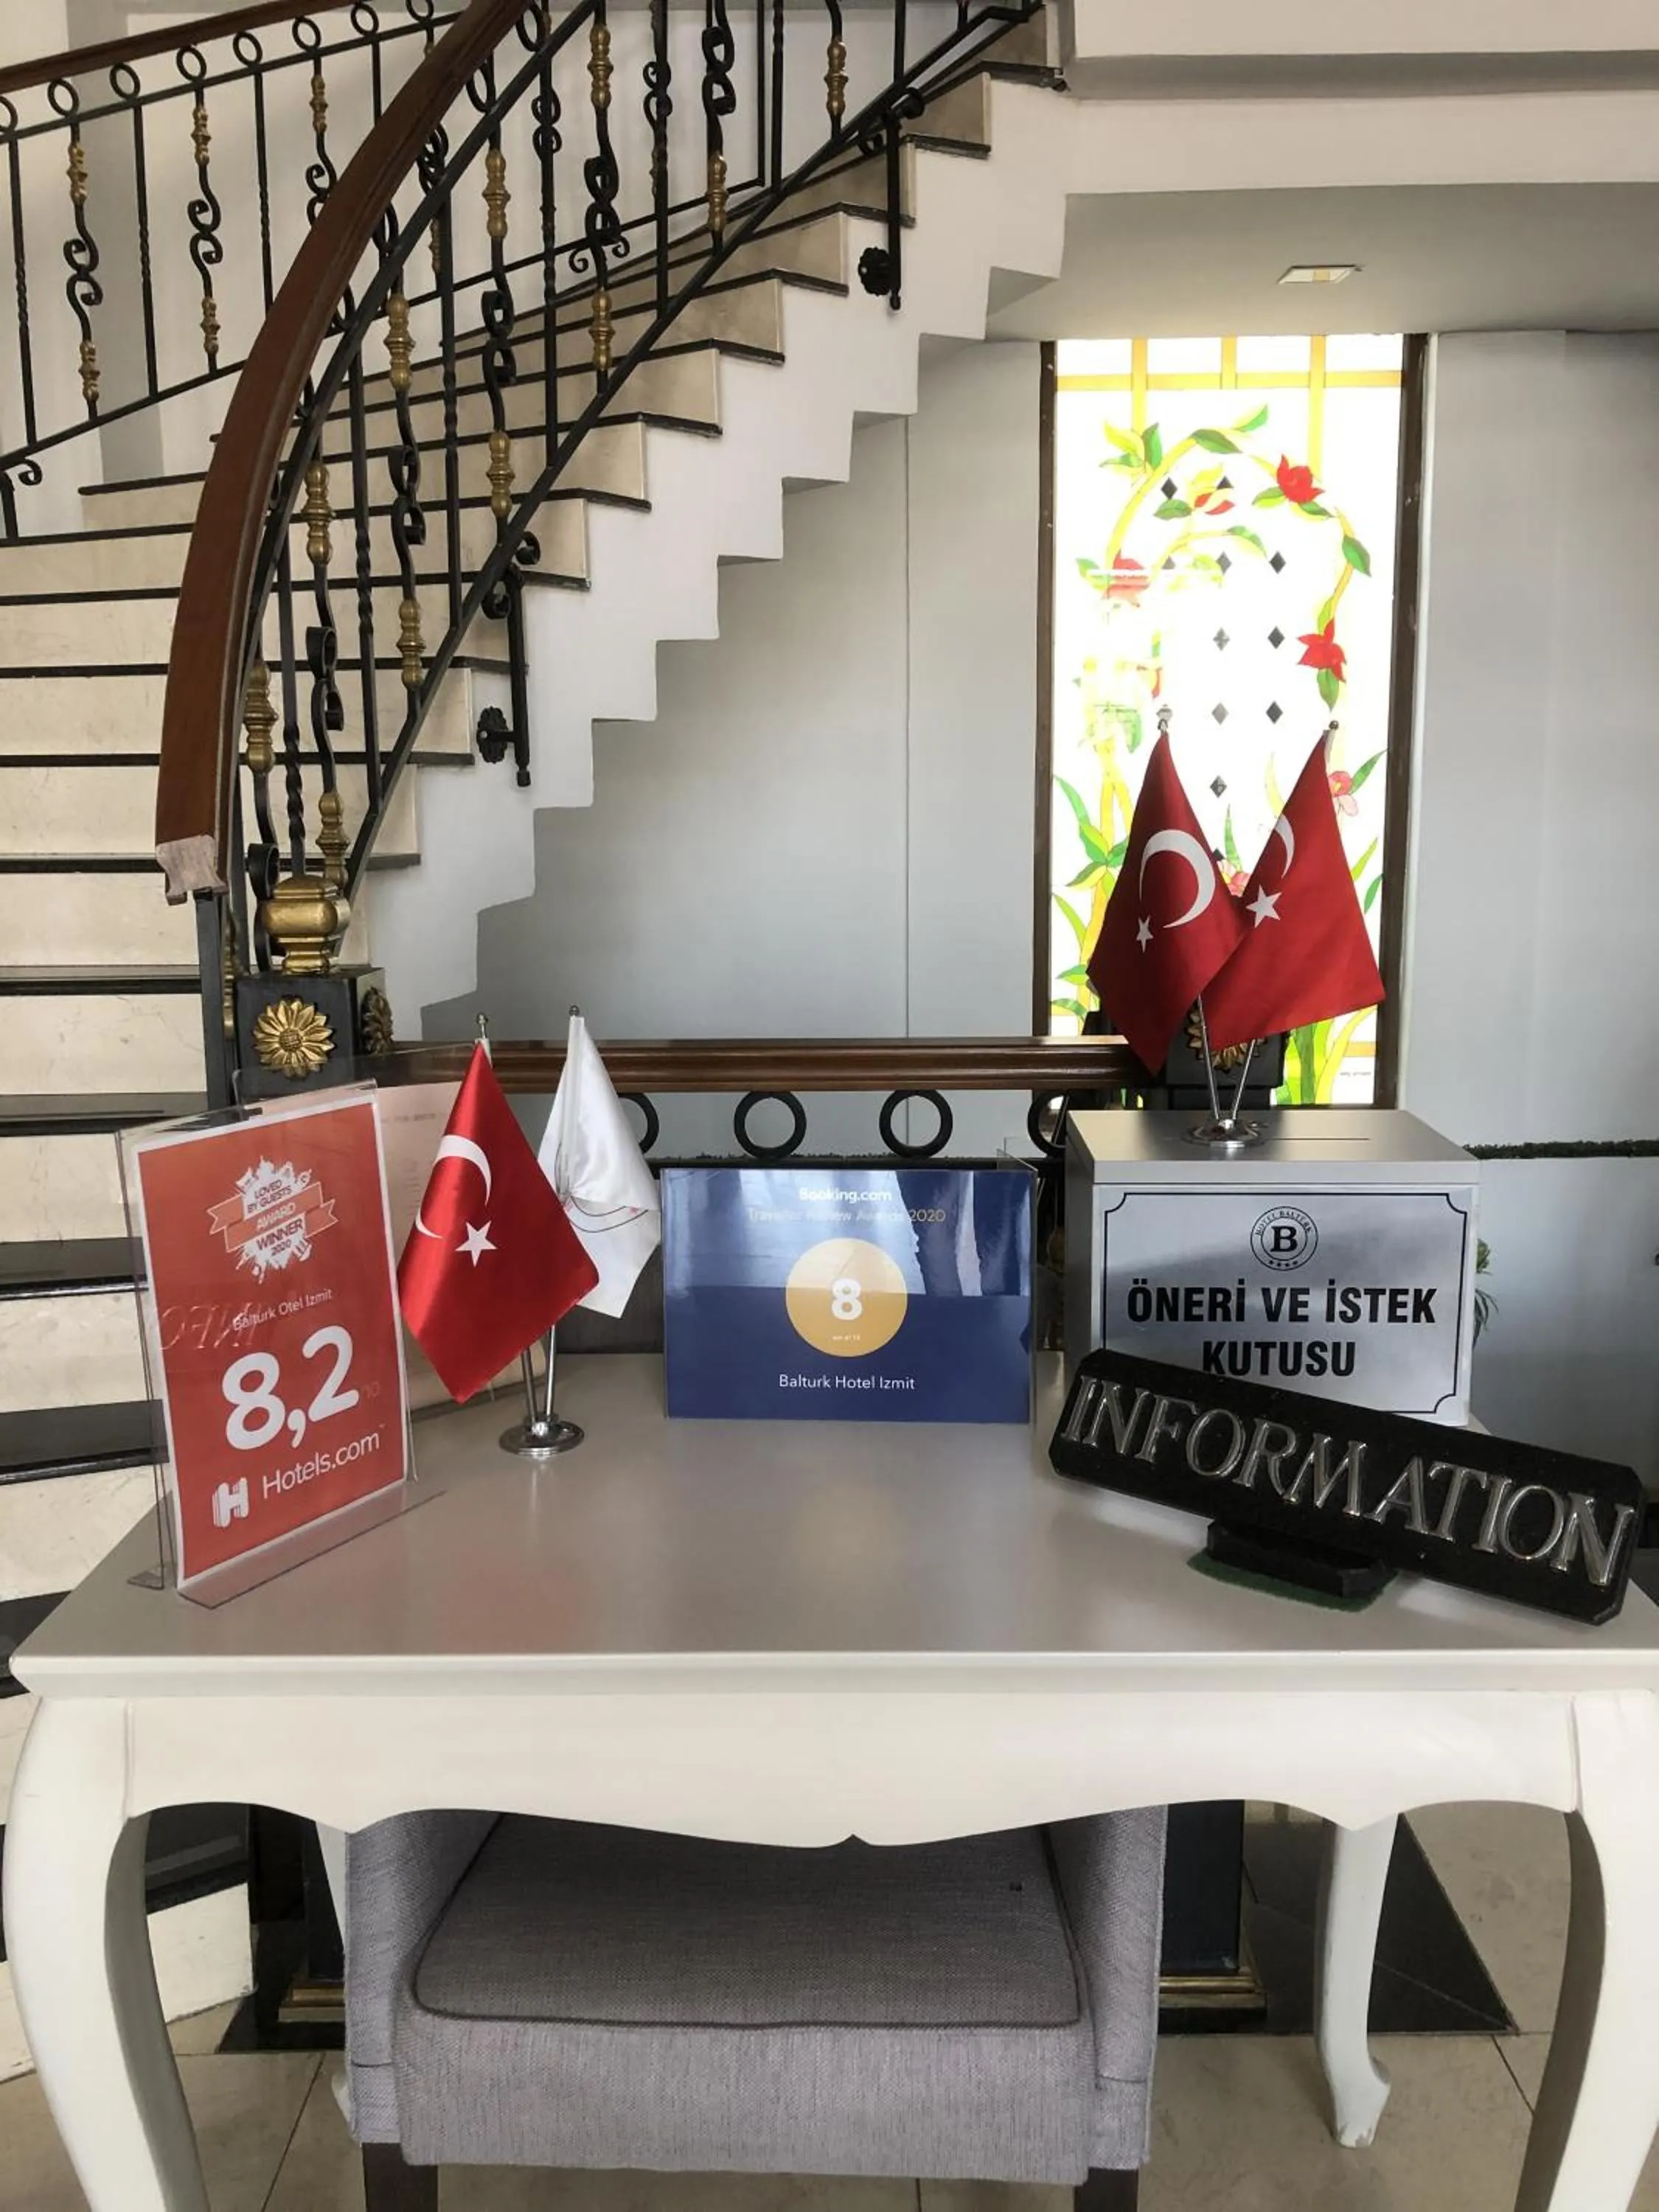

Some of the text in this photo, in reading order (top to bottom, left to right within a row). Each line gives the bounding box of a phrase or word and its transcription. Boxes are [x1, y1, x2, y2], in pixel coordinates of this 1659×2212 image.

[247, 1186, 293, 1214] BY GUESTS
[254, 1180, 282, 1199] LOVED
[799, 1187, 892, 1204] Booking.com
[909, 1208, 947, 1222] 2020
[257, 1218, 304, 1251] WINNER
[271, 1239, 292, 1256] 2020
[1270, 1225, 1298, 1253] B
[278, 1297, 304, 1315] Otel
[831, 1278, 863, 1321] 8
[1127, 1278, 1437, 1324] ÖNERİ VE İSTEK
[1203, 1340, 1356, 1377] KUTUSU
[222, 1325, 360, 1450] 8,2
[779, 1374, 916, 1390] Balturk Hotel Izmit
[262, 1432, 380, 1499] Hotels.com
[1060, 1375, 1635, 1587] INFORMATION
